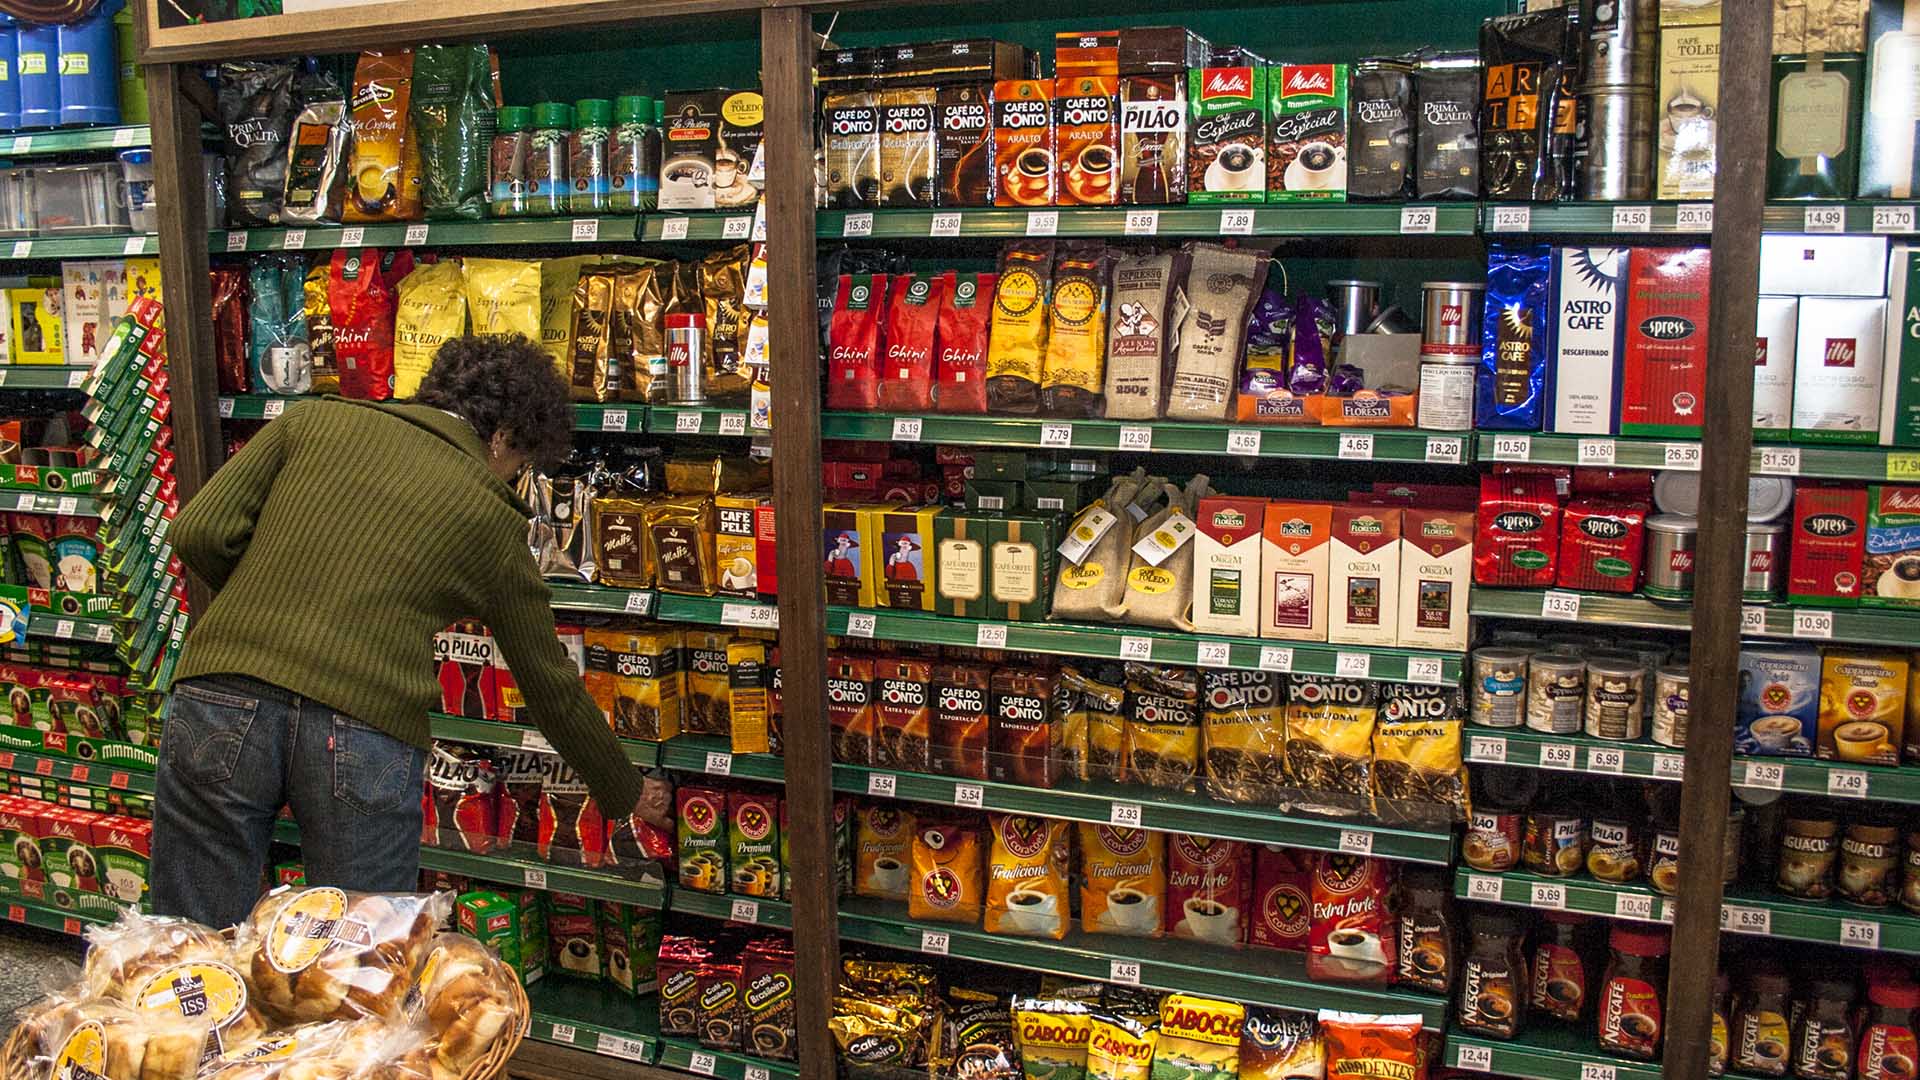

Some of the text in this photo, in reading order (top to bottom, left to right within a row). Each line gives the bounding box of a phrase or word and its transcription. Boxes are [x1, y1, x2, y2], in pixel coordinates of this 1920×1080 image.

[1206, 72, 1249, 92] Melitta
[1284, 71, 1329, 90] Melitta
[1005, 100, 1044, 113] CAFÉ DO
[1066, 96, 1107, 109] CAFÉ DO
[1357, 101, 1391, 114] PRIMA
[1423, 101, 1458, 115] PRIMA
[834, 109, 871, 121] CAFÉ DO
[888, 106, 925, 119] CAFÉ DO
[945, 104, 984, 117] CAFÉ DO
[1064, 107, 1108, 125] PONTO
[944, 114, 986, 130] PONTO
[1002, 111, 1046, 128] PONTO
[1124, 106, 1179, 129] PILÃO
[1276, 109, 1337, 137] Especial
[832, 119, 873, 136] PONTO
[886, 117, 928, 133] PONTO
[1197, 111, 1255, 139] Especial
[1008, 134, 1041, 144] ARALTO
[1069, 130, 1104, 140] ARALTO
[1035, 216, 1056, 227] 9,59
[1226, 215, 1249, 226] 7,89
[1408, 214, 1431, 225] 7,29
[1495, 213, 1528, 224] 12,50
[1615, 212, 1647, 224] 14,50
[1679, 210, 1712, 223] 20,10
[1807, 212, 1841, 224] 14,99
[1875, 212, 1911, 225] 21,70
[575, 224, 596, 235] 15,90
[666, 222, 687, 233] 16,40
[727, 221, 746, 233] 9,39
[847, 219, 872, 231] 15,80
[933, 218, 959, 229] 15,80
[1441, 306, 1462, 322] illy
[1564, 300, 1612, 315] ASTRO
[1649, 320, 1685, 337] spress
[577, 336, 600, 345] ASTRO
[1499, 341, 1530, 353] ASTRO
[670, 346, 689, 365] illy
[833, 346, 871, 360] Ghini
[888, 345, 928, 359] Ghini
[942, 349, 983, 363] Ghini
[1562, 349, 1609, 357] DESCAFEINADO
[1825, 342, 1855, 367] illy
[1115, 384, 1149, 397] 250g
[1258, 404, 1303, 416] FLORESTA
[1344, 405, 1389, 417] FLORESTA
[604, 414, 626, 426] 10,40
[678, 416, 701, 428] 31,90
[899, 423, 919, 434] 8,19
[1048, 429, 1070, 441] 7,79
[1122, 432, 1150, 444] 12,90
[1234, 436, 1257, 448] 4,65
[1346, 438, 1370, 451] 4,65
[1429, 444, 1459, 457] 18,20
[1497, 441, 1527, 454] 10,50
[1583, 445, 1613, 458] 19,60
[1667, 449, 1699, 462] 26,50
[1763, 454, 1796, 468] 31,50
[721, 510, 751, 523] CAFÉ
[1503, 516, 1534, 530] spress
[721, 521, 751, 534] PELÉ
[1587, 520, 1619, 536] spress
[1812, 518, 1847, 533] spress
[1672, 554, 1692, 569] illy
[1751, 554, 1771, 570] illy
[1548, 600, 1577, 613] 13,50
[750, 608, 770, 620] 5,89
[854, 619, 873, 630] 9,29
[1799, 617, 1830, 630] 10,90
[980, 630, 1005, 641] 12,50
[452, 640, 491, 659] PILÃO
[1129, 642, 1149, 654] 7,99
[1205, 648, 1226, 659] 7,29
[618, 654, 635, 664] CAFÉ
[694, 650, 711, 661] CAFÉ
[1267, 653, 1289, 665] 7,29
[617, 662, 651, 676] PONTO
[692, 659, 729, 674] PONTO
[1344, 657, 1366, 669] 7,29
[1415, 663, 1438, 675] 7,29
[884, 680, 922, 694] CAFÉ DO
[941, 687, 980, 700] CAFÉ DO
[1289, 683, 1362, 703] PONTO
[882, 688, 923, 704] PONTO
[1001, 695, 1040, 709] CAFÉ DO
[1137, 695, 1162, 708] CAFÉ
[939, 697, 983, 712] PONTO
[1000, 704, 1043, 721] PONTO
[1135, 705, 1187, 723] PONTO
[1480, 743, 1503, 755] 7,19
[1547, 749, 1571, 761] 6,99
[712, 757, 728, 768] 5,54
[1595, 754, 1620, 766] 6,99
[1755, 767, 1780, 780] 9,39
[874, 778, 893, 790] 5,54
[1836, 775, 1861, 788] 7,49
[961, 790, 980, 801] 5,54
[1117, 808, 1138, 820] 2,93
[1594, 826, 1624, 842] PILÃO
[684, 836, 717, 848] Premium
[1347, 835, 1369, 847] 5,54
[737, 841, 772, 855] Premium
[1090, 860, 1153, 880] Tradicional
[1170, 871, 1200, 887] Extra
[1476, 881, 1498, 893] 8,79
[1537, 889, 1561, 901] 9,69
[737, 905, 755, 917] 5,49
[1313, 897, 1377, 919] Extra forte
[1621, 900, 1650, 914] 10,40
[1741, 912, 1766, 926] 6,99
[1848, 926, 1874, 939] 5,19
[928, 936, 946, 947] 2,47
[1400, 916, 1415, 978] NESCAFÉ
[1117, 965, 1137, 977] 4,45
[751, 974, 772, 990] Café
[1533, 949, 1551, 1008] NESCAFÉ
[1463, 961, 1482, 1024] NESCAFÉ
[1602, 978, 1625, 1044] NESCAFÉ
[1024, 1025, 1090, 1044] CABOCLO
[1741, 1011, 1759, 1067] NESCAFÉ
[622, 1040, 641, 1054] 5,69
[696, 1055, 714, 1067] 2,26
[1462, 1048, 1490, 1062] 12,44
[1584, 1066, 1614, 1080] 12,44
